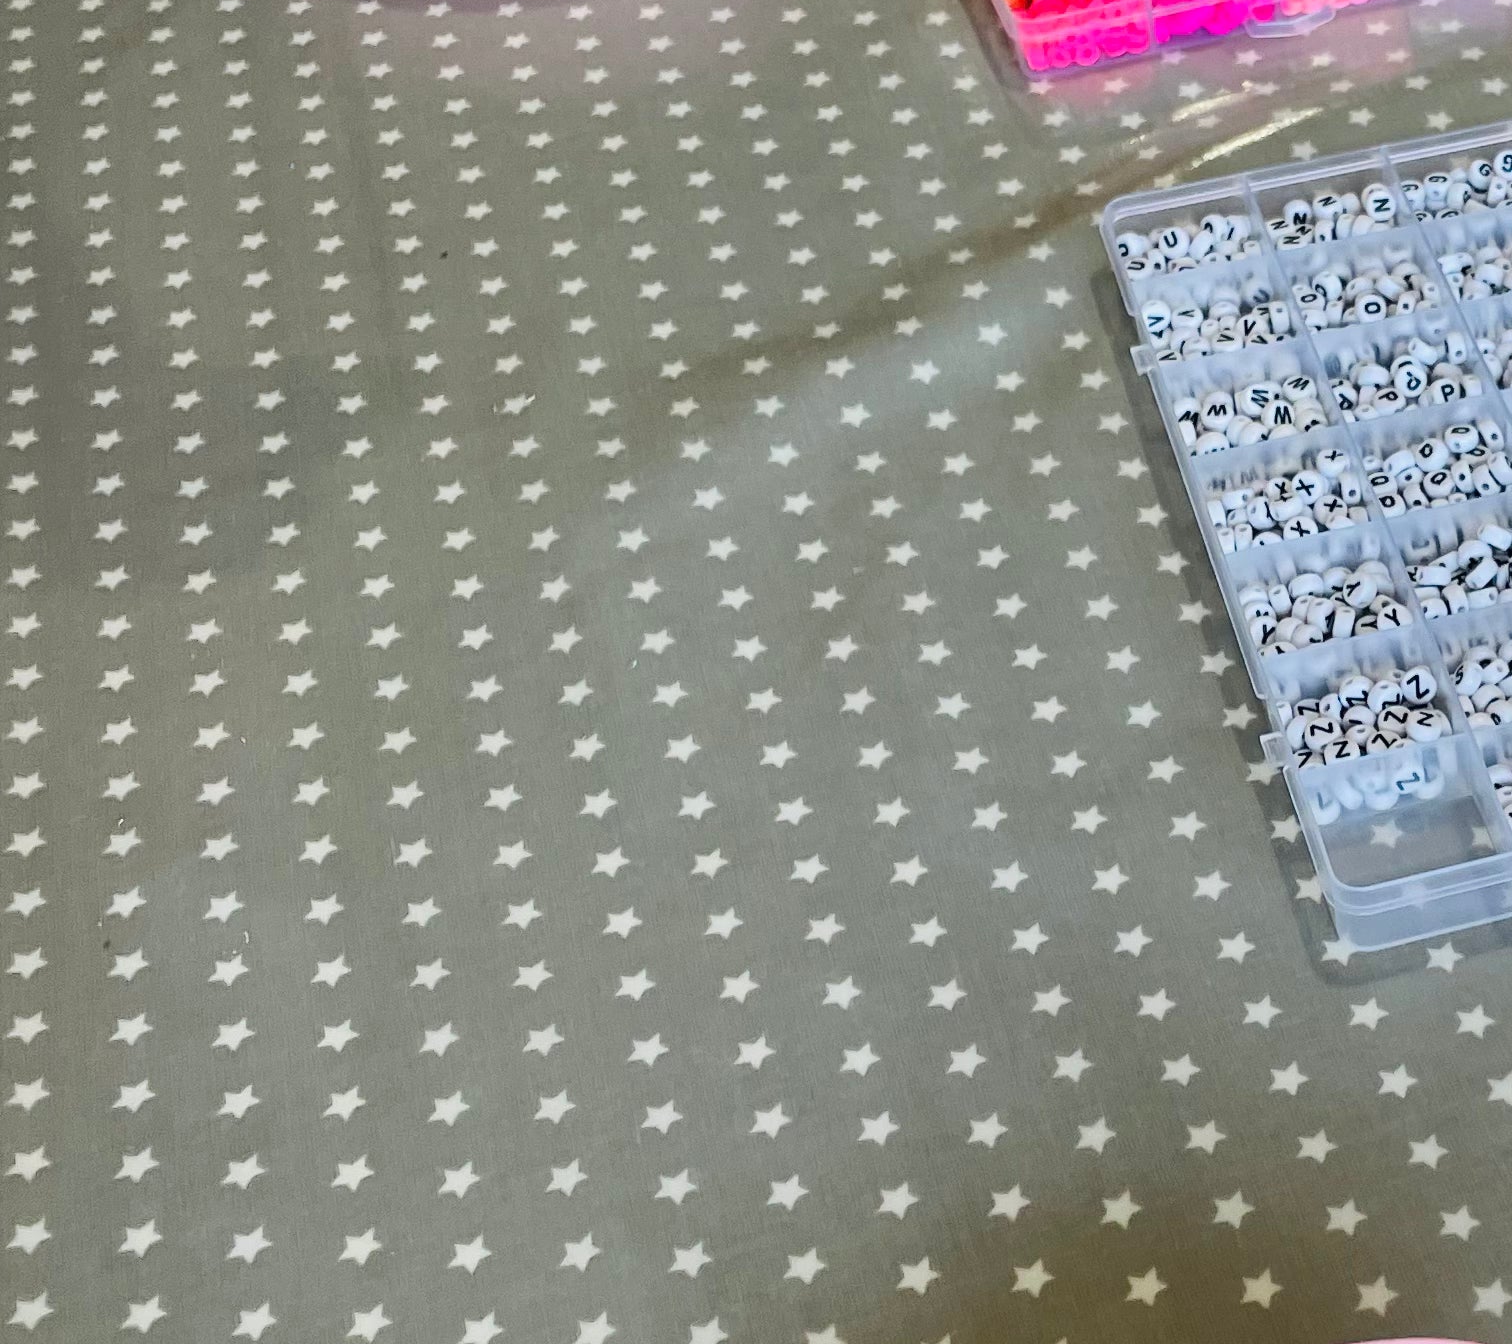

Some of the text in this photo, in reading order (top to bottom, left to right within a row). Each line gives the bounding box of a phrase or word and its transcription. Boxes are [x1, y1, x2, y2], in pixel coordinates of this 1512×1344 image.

[1318, 196, 1337, 207] N
[1373, 198, 1391, 213] N
[1163, 231, 1178, 248] U
[1364, 301, 1381, 315] O
[1243, 319, 1257, 337] V
[1378, 390, 1399, 402] P
[1440, 383, 1455, 403] P
[1295, 478, 1315, 497] X
[1323, 498, 1343, 513] X
[1290, 520, 1311, 538] X
[1383, 608, 1401, 627] Y
[1406, 674, 1430, 700] Z
